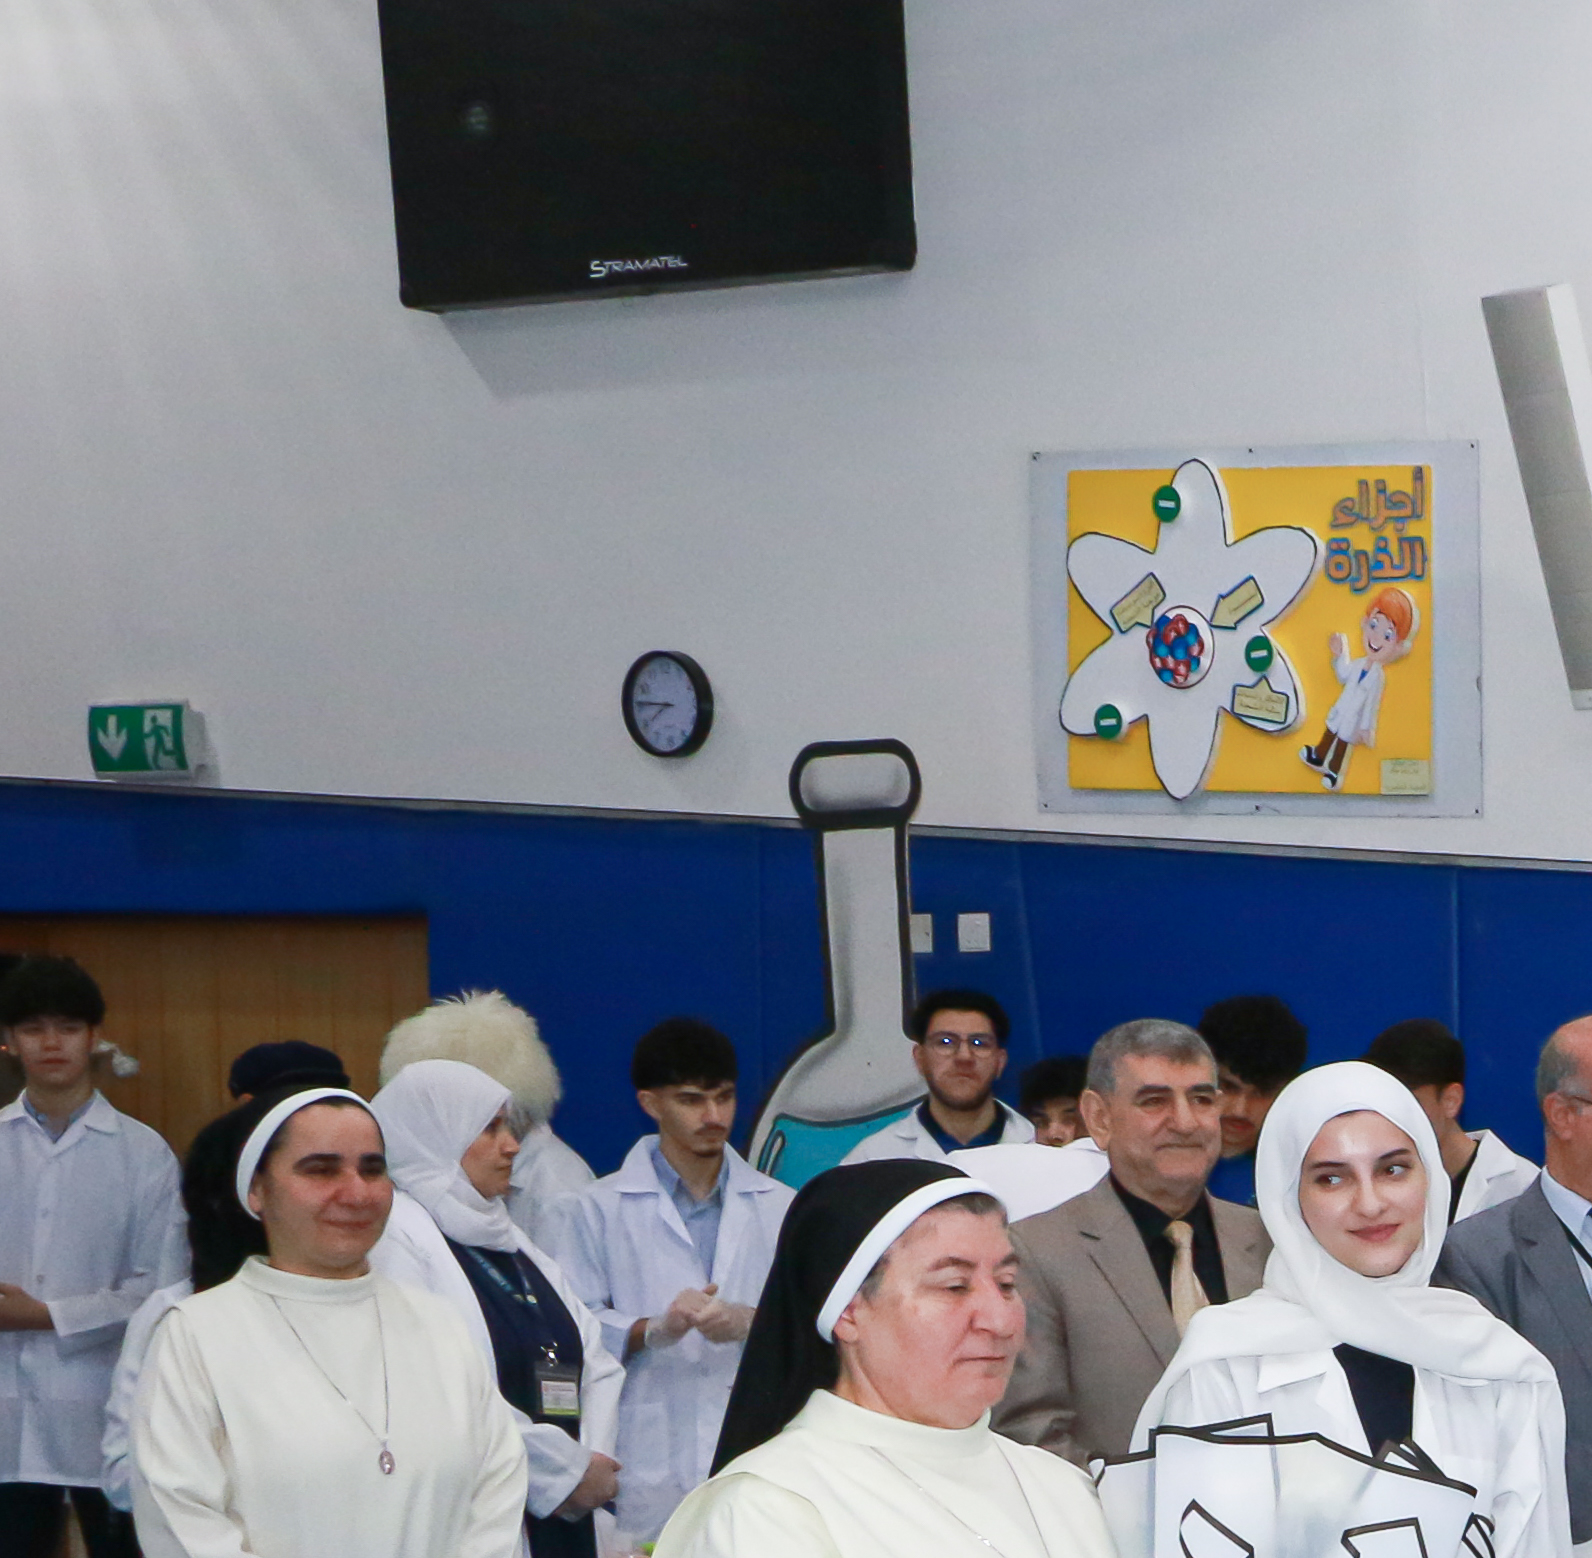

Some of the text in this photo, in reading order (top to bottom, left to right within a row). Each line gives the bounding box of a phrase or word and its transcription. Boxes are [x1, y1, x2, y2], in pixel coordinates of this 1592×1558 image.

[589, 255, 688, 278] STRAMATEL
[1330, 465, 1425, 534] أجزاء
[1325, 536, 1427, 593] الذرة
